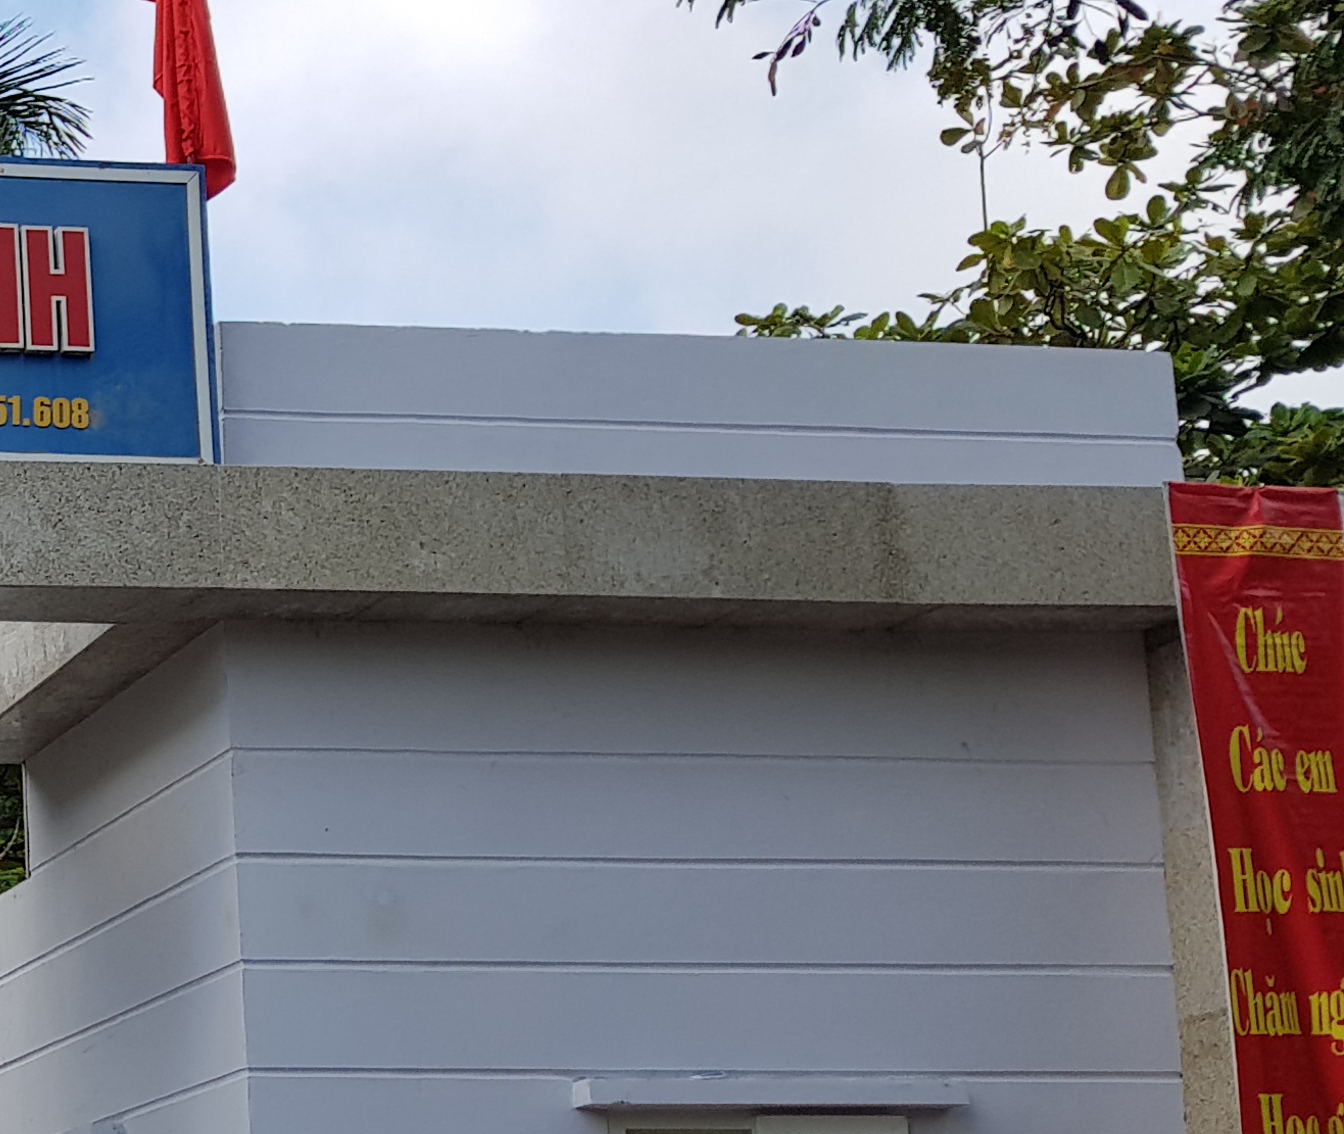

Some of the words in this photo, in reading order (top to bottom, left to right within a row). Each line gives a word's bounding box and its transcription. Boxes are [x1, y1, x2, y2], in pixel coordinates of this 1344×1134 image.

[1235, 606, 1308, 675] Chúc
[1229, 724, 1287, 793] Các
[1296, 750, 1338, 794] em
[1228, 847, 1293, 936] Học
[1230, 968, 1302, 1036] Chăm
